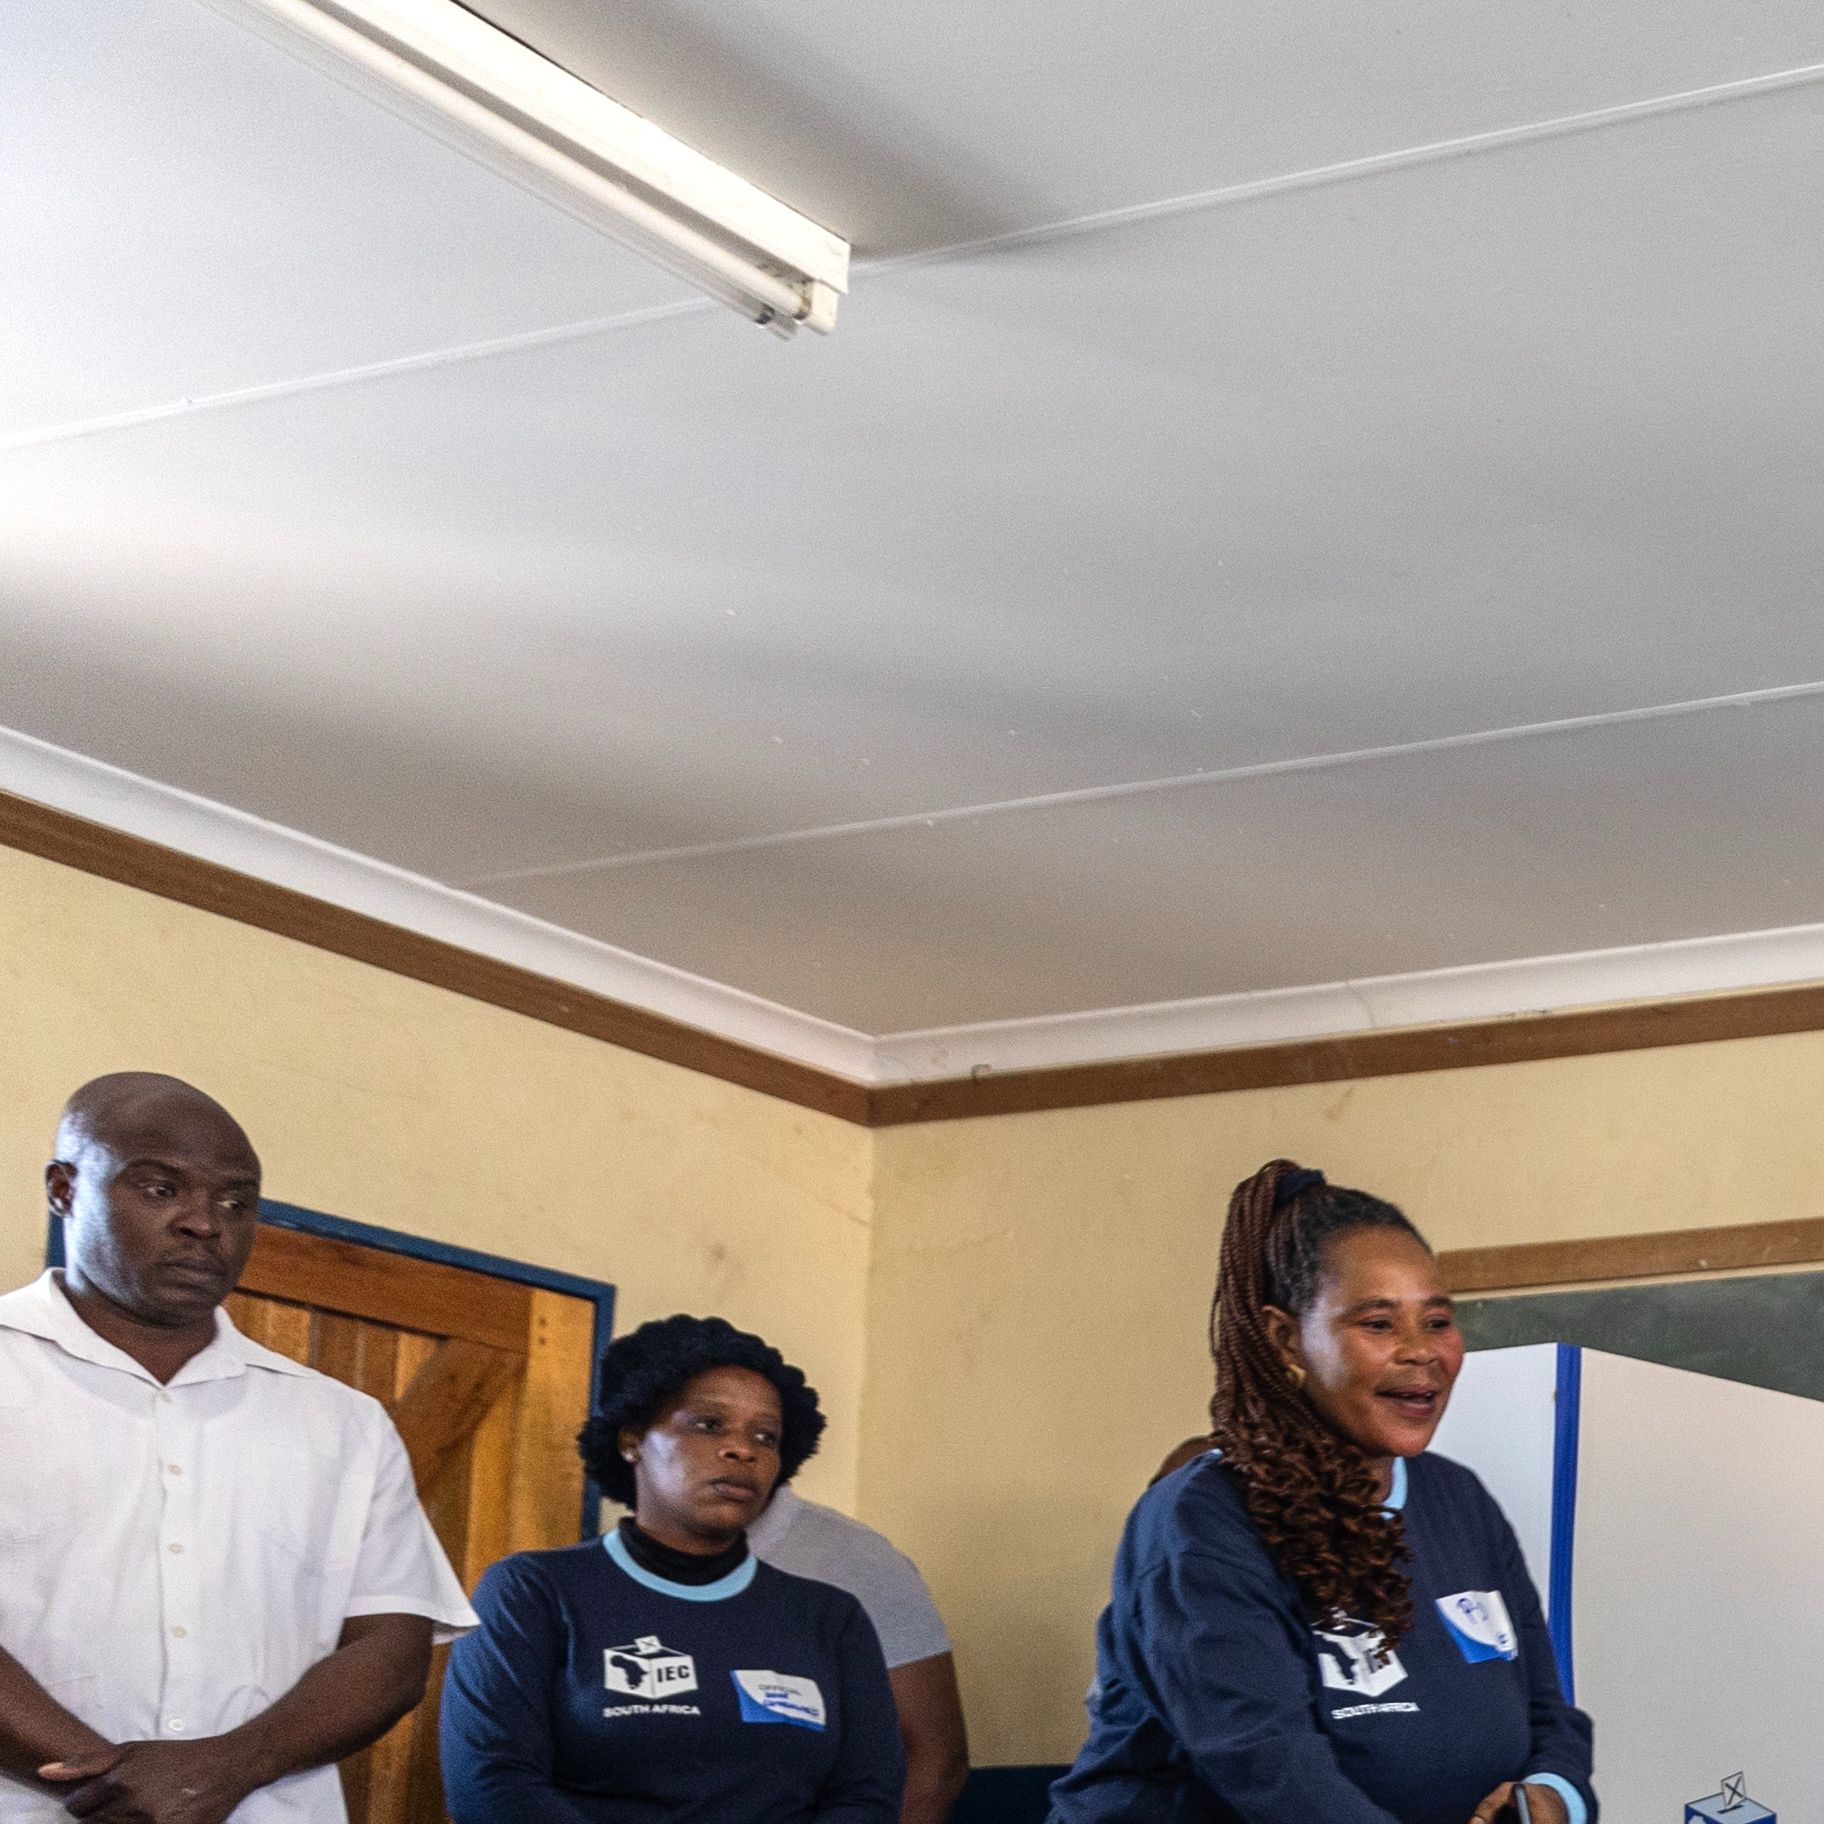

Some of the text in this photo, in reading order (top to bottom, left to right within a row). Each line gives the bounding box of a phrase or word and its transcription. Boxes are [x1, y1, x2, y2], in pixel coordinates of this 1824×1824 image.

[657, 1665, 690, 1683] IEC
[603, 1704, 701, 1718] SOUTH AFRICA
